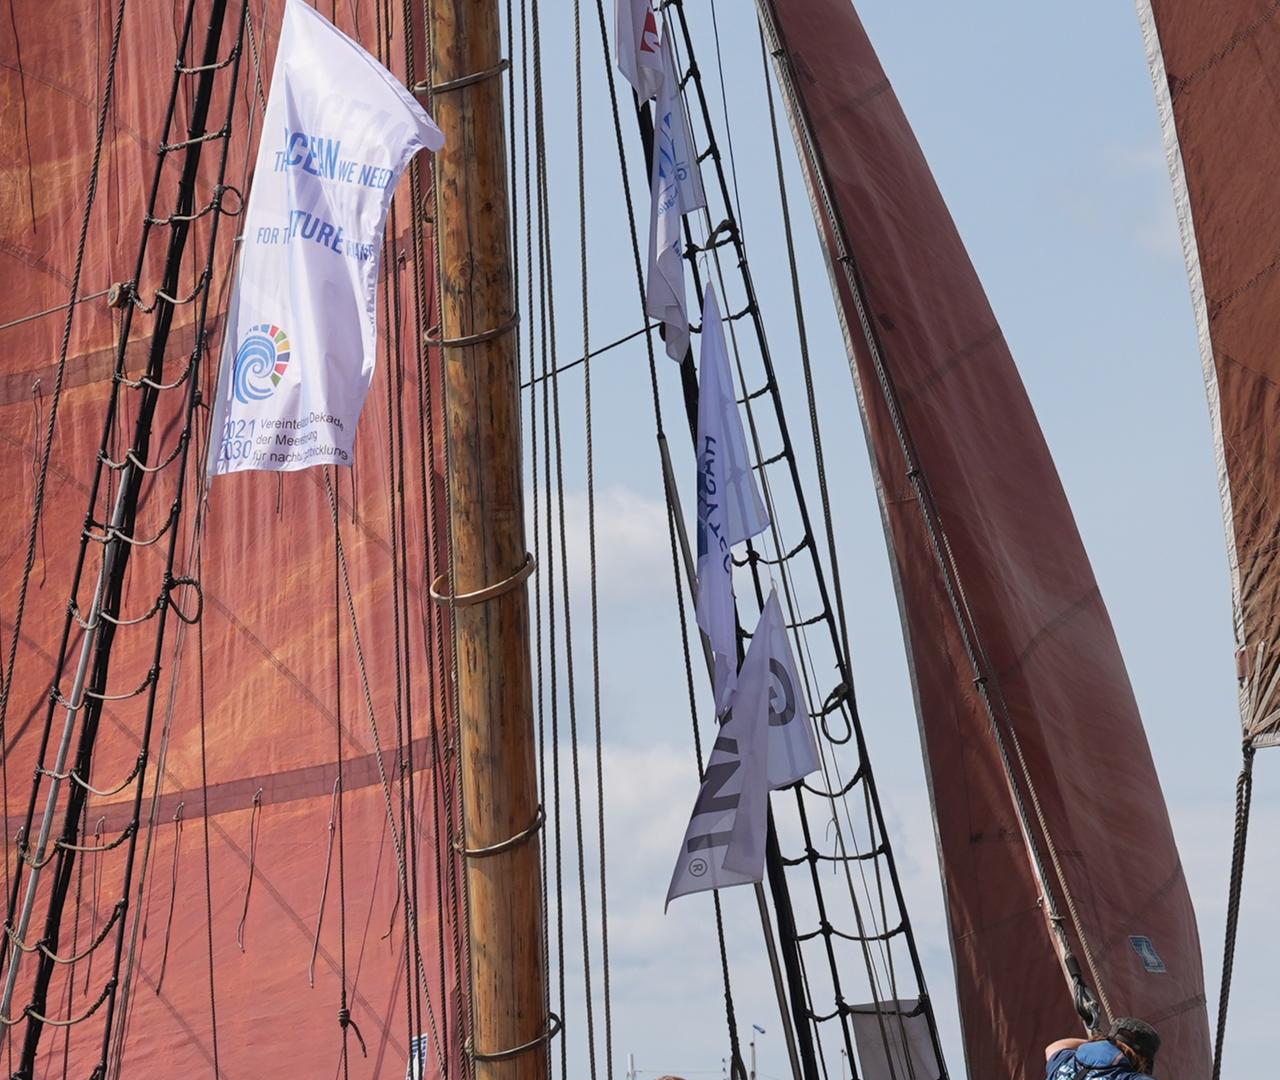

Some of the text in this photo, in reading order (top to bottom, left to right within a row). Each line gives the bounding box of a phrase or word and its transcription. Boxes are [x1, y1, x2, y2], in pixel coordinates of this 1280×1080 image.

[338, 160, 358, 183] WE
[357, 164, 394, 190] NEED
[256, 227, 280, 244] FOR
[255, 433, 273, 446] der
[252, 451, 267, 463] für
